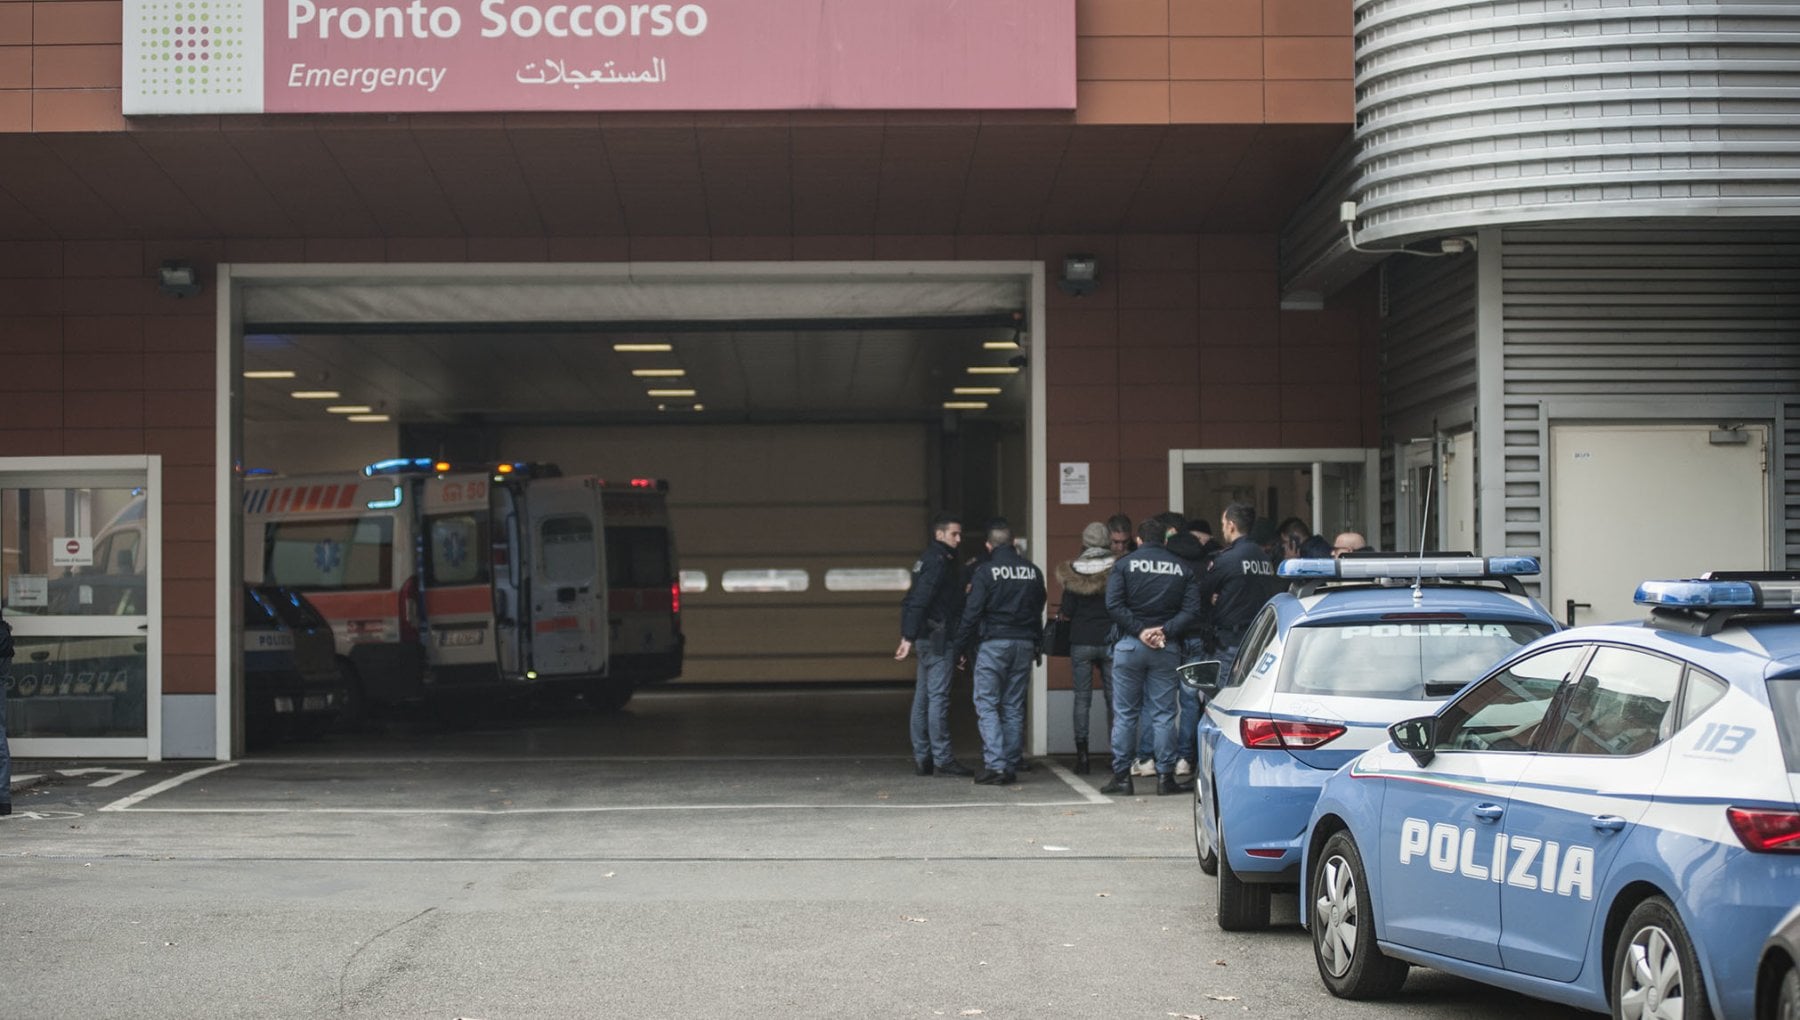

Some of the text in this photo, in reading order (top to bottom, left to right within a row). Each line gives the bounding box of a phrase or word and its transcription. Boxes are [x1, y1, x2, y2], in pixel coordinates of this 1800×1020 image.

[288, 0, 708, 39] Pronto Soccorso
[288, 63, 447, 93] Emergency
[515, 56, 667, 90] المستعجلات
[991, 566, 1037, 580] POLIZIA
[1129, 559, 1184, 577] POLIZIA
[1341, 623, 1512, 640] POLIZIA
[1692, 722, 1757, 755] 113
[1399, 816, 1595, 901] POLIZIA
